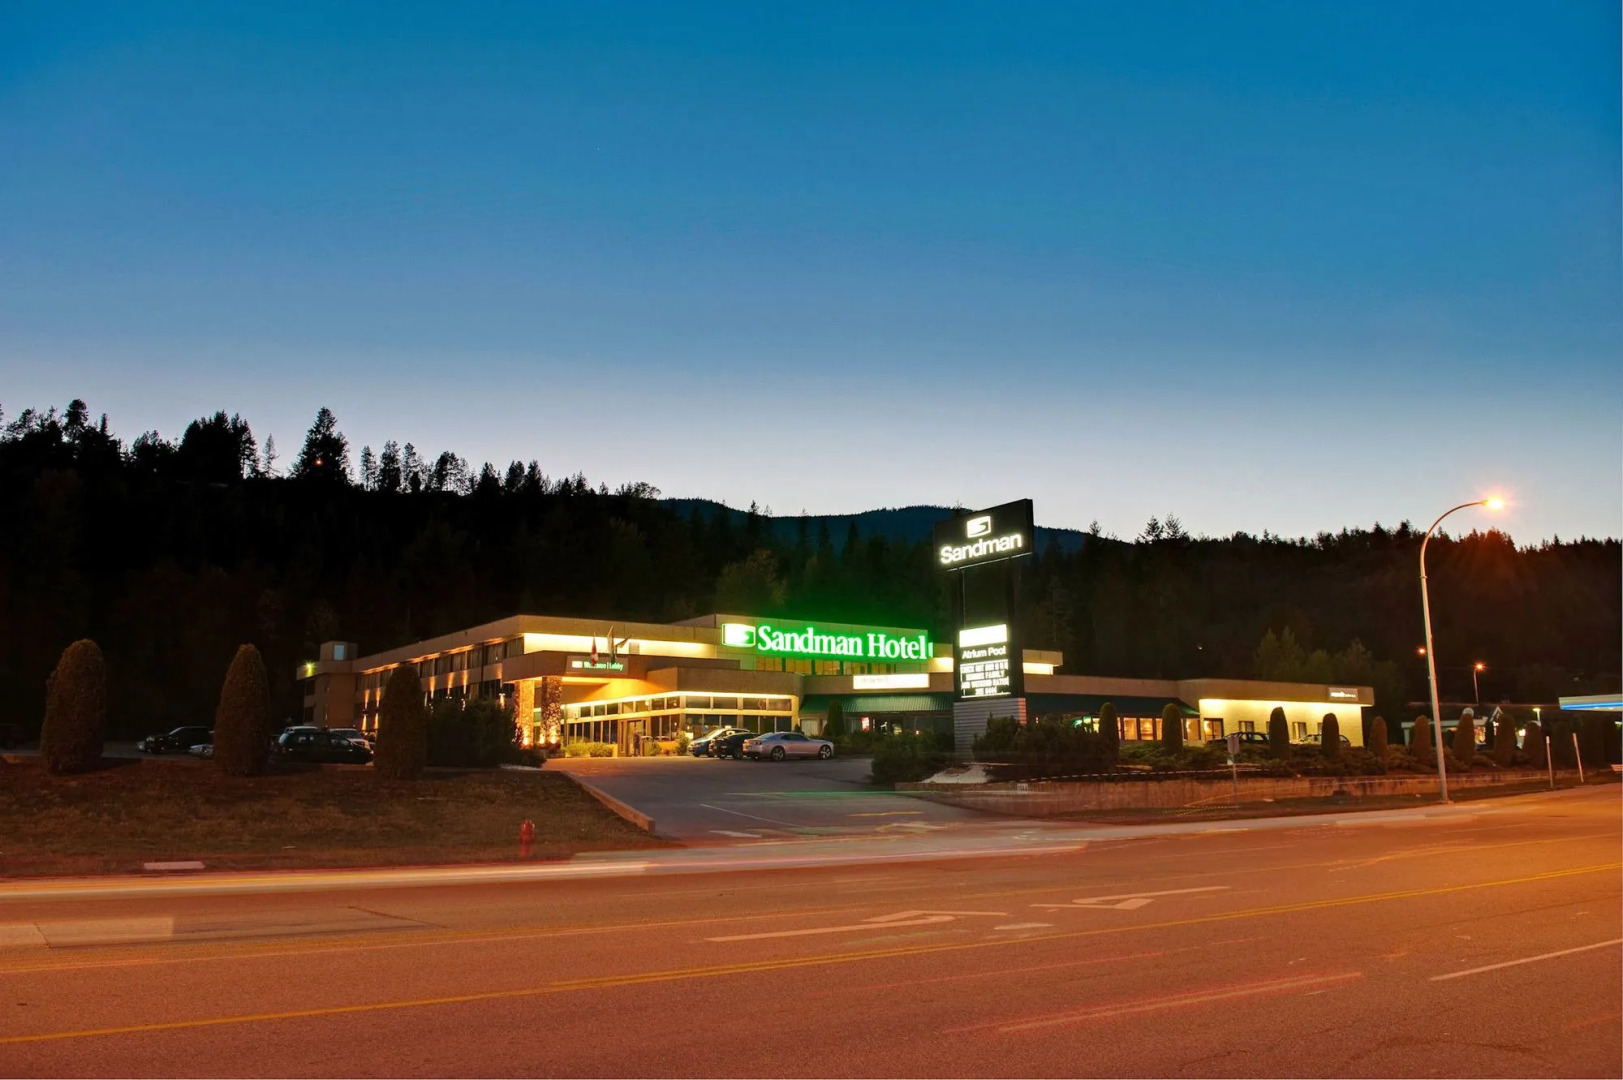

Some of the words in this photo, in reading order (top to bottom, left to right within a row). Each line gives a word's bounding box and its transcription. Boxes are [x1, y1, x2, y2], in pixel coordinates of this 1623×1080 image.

[940, 534, 1022, 564] Sandman
[757, 625, 864, 657] Sandman
[867, 633, 927, 660] Hotel
[961, 649, 987, 659] Atrium
[987, 645, 1006, 657] Pool
